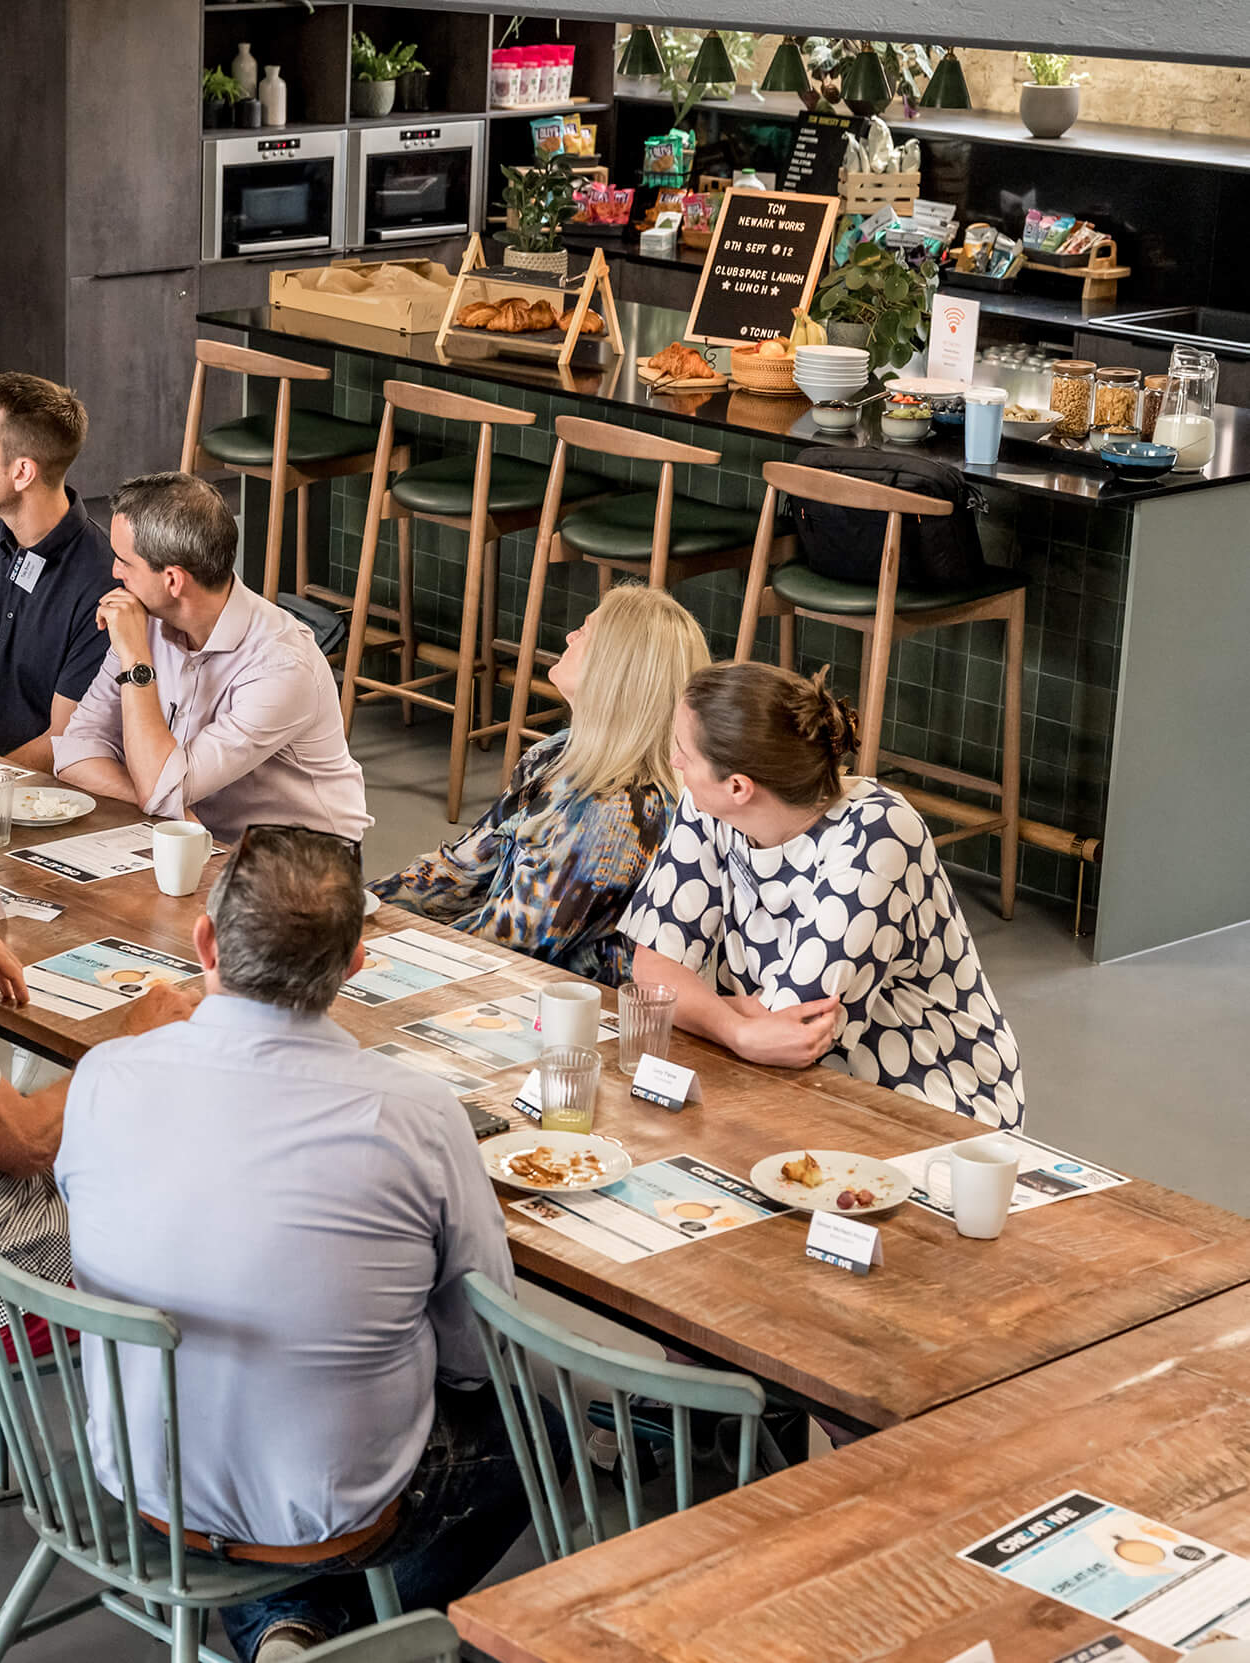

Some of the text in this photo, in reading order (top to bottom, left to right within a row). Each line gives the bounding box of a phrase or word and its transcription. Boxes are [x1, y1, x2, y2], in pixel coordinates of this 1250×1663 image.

[767, 202, 787, 215] TCN
[738, 215, 806, 232] NEWARK WORKS
[724, 240, 742, 252] 8TH
[745, 243, 767, 254] SEPT
[714, 265, 805, 285] CLUBSPACE LAUNCH
[734, 281, 768, 295] LUNCH
